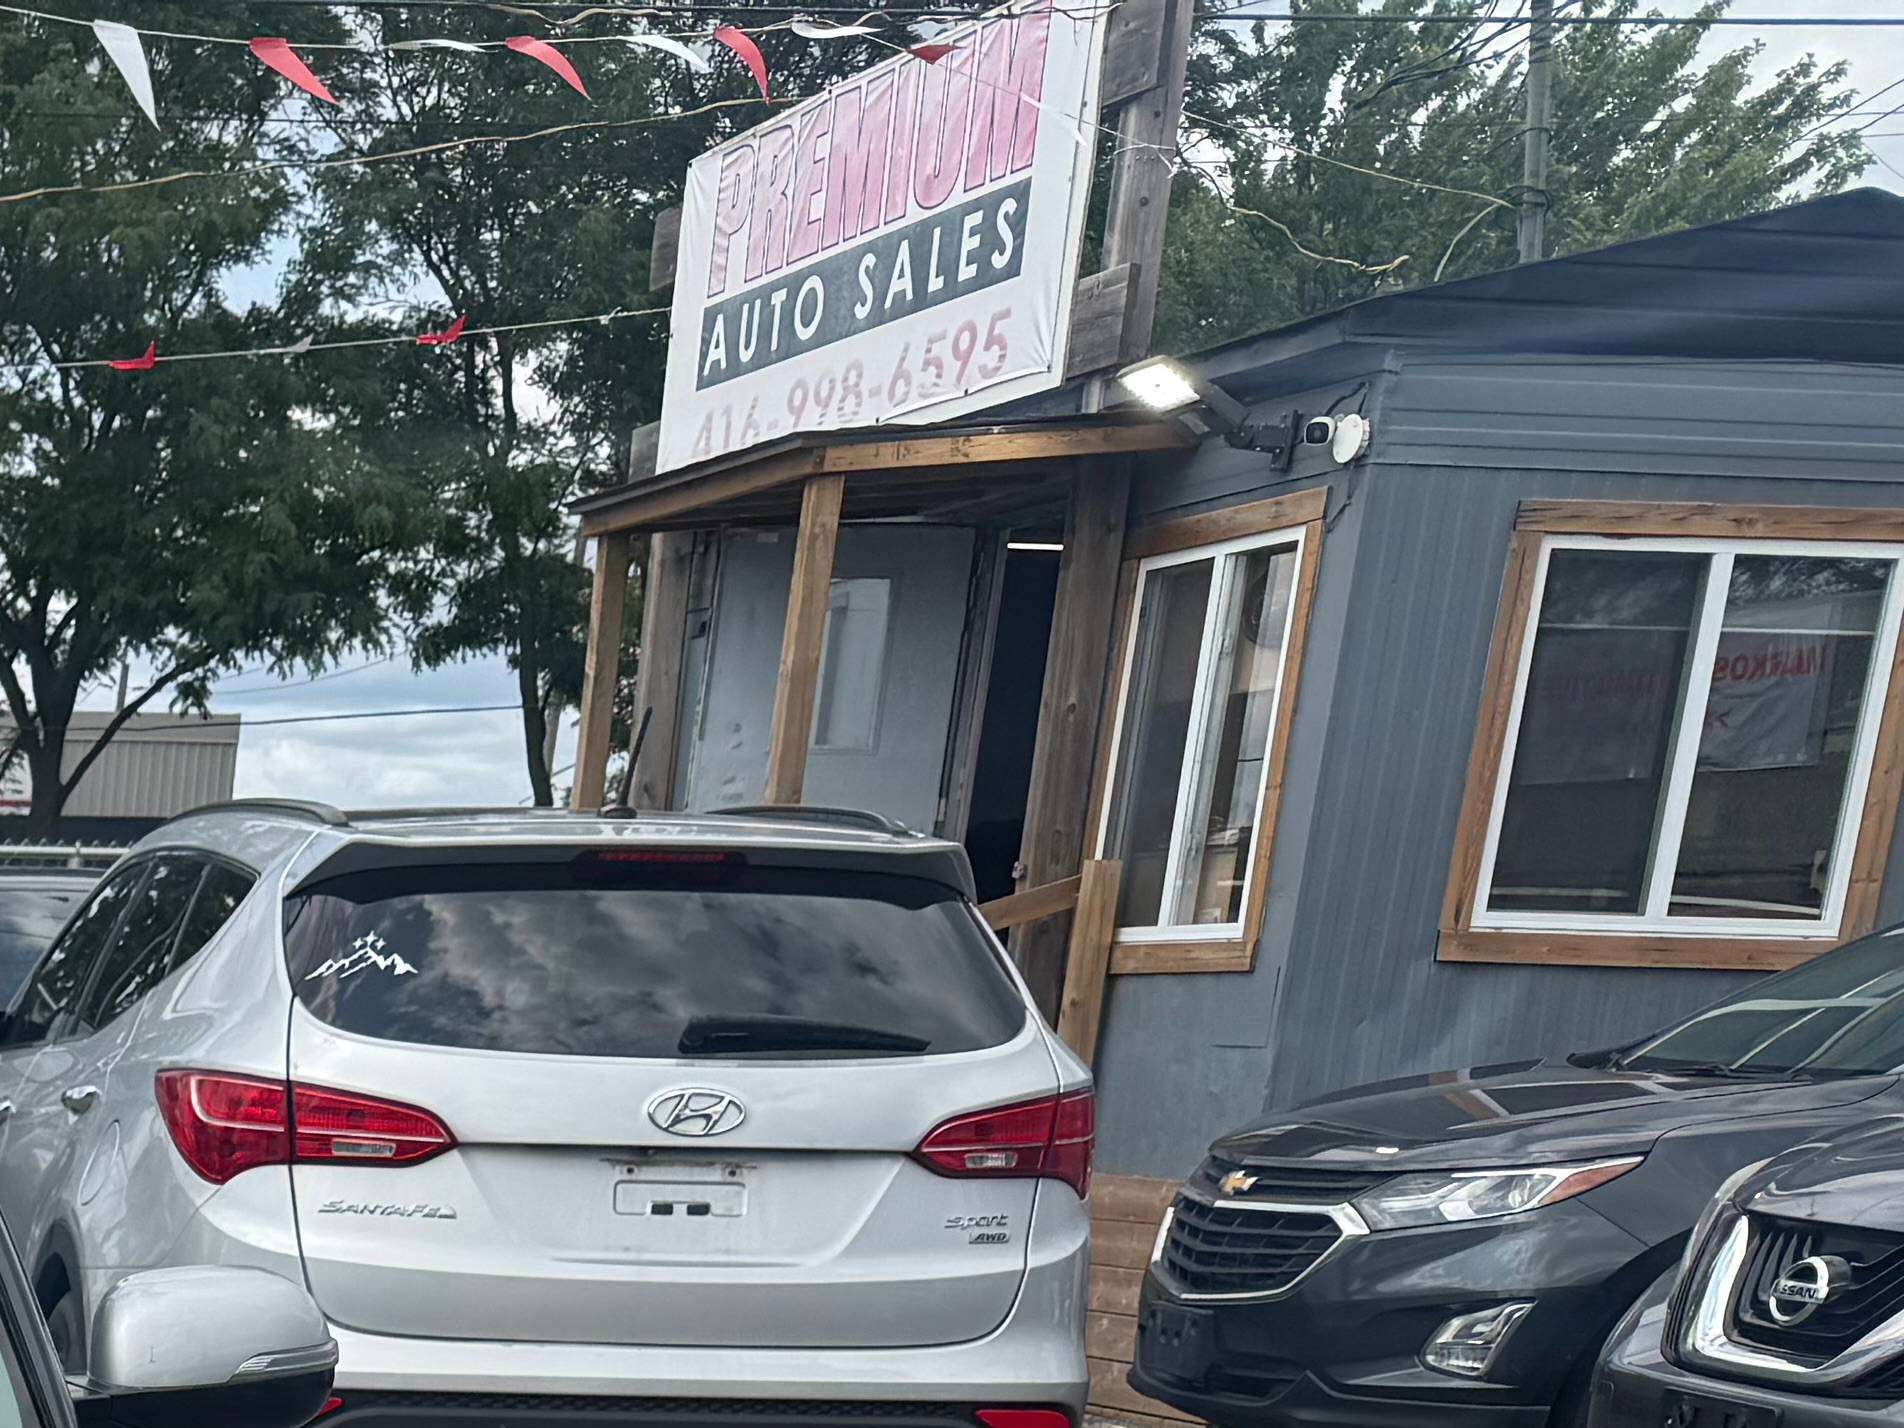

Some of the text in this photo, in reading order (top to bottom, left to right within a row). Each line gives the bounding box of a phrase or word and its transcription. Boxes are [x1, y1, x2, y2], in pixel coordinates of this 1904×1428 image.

[708, 0, 1054, 298] PREMIUM
[703, 197, 1018, 377] AUTO SALES
[975, 1232, 1007, 1242] AWD
